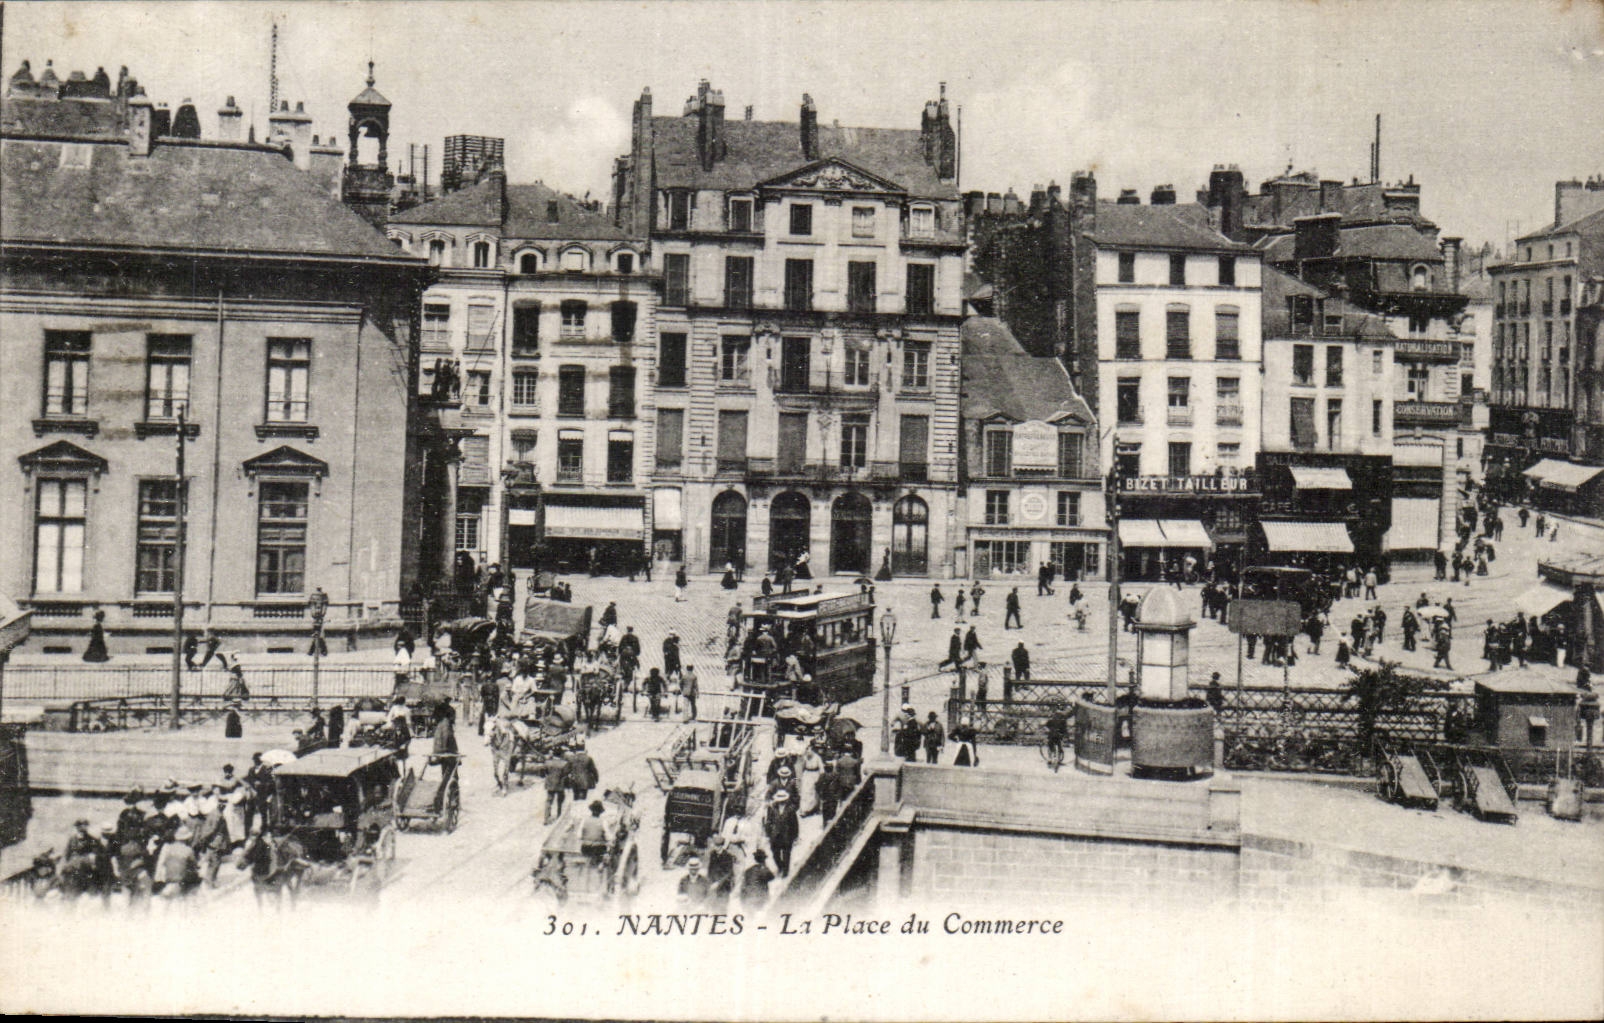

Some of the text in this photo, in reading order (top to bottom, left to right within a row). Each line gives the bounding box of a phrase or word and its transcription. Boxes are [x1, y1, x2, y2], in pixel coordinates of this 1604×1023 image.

[1395, 404, 1455, 417] CONSERVATION
[1125, 477, 1248, 491] BIZET TAILLEUR
